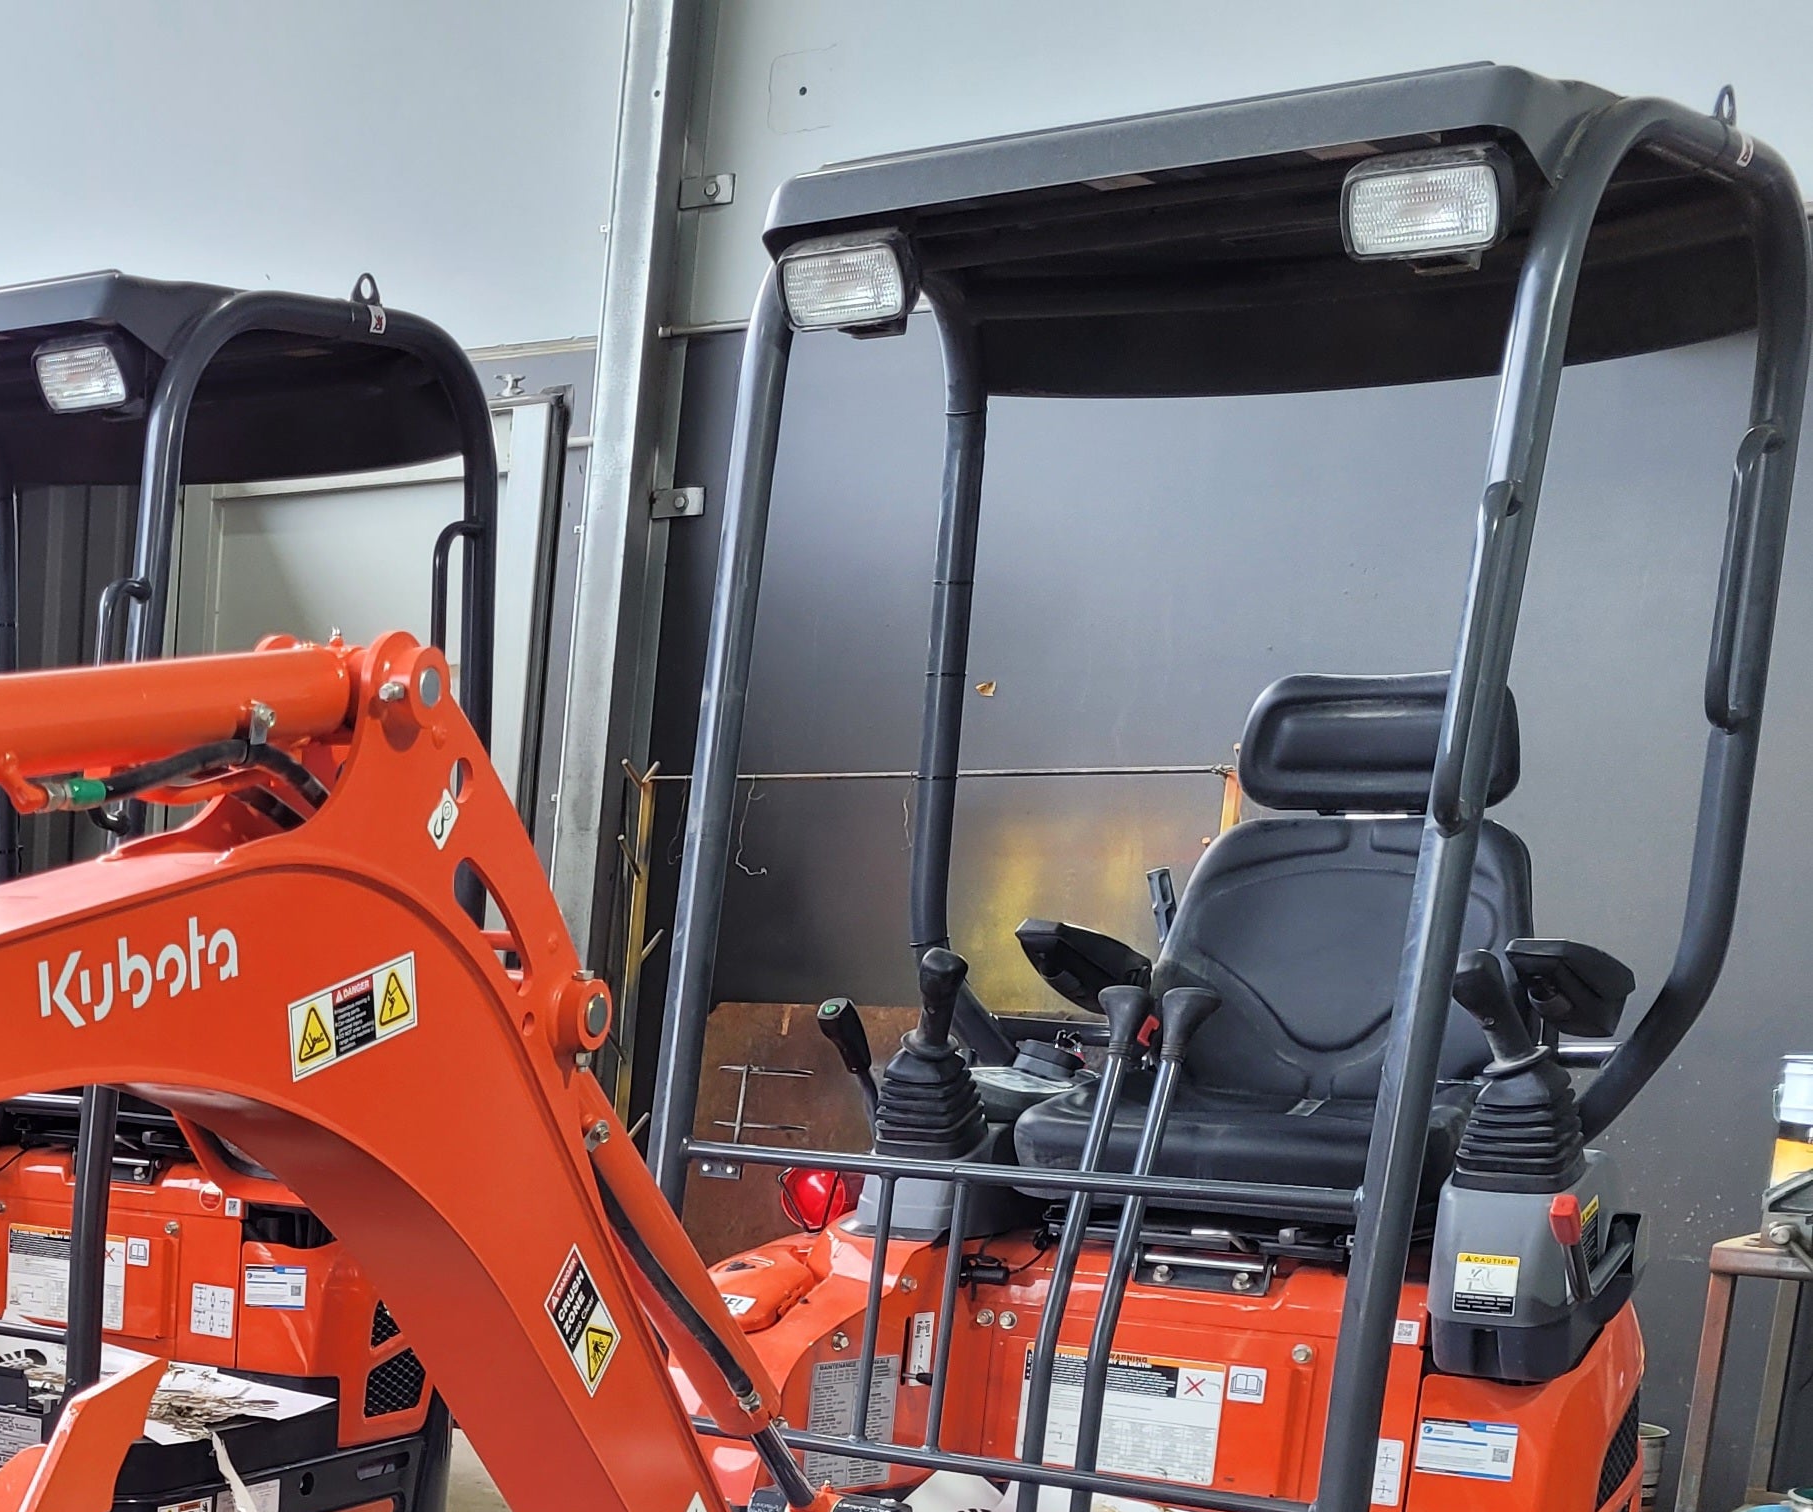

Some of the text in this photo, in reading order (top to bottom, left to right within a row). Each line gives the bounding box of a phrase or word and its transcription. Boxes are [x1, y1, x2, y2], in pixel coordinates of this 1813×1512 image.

[38, 916, 239, 1029] Kubota
[343, 980, 369, 999] DANGER
[556, 1257, 577, 1297] DANGER
[1474, 1257, 1513, 1265] CAUTION
[558, 1269, 585, 1322] CRUSH
[563, 1290, 586, 1335] ZONE
[569, 1293, 595, 1345] Keep Clear
